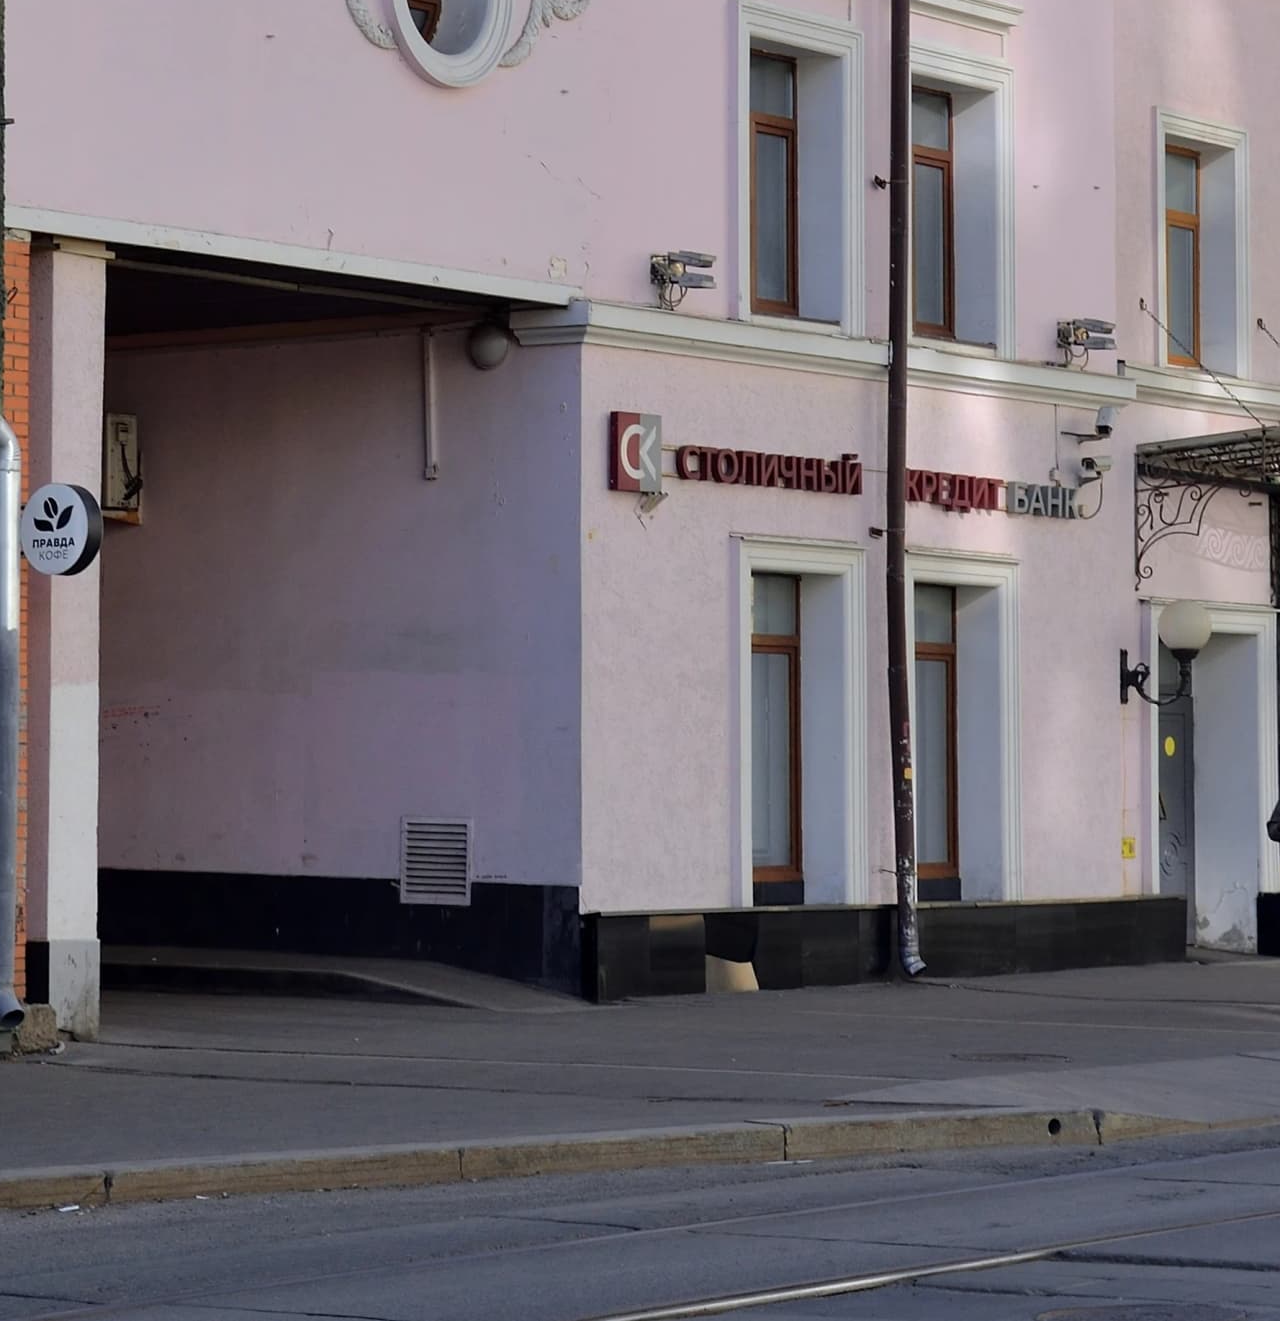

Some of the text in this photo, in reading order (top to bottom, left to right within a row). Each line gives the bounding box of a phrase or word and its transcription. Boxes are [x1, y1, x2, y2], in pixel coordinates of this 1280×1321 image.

[677, 445, 862, 495] СТОЛИЧНЫЙ
[905, 468, 1004, 513] КРЕДИТ
[32, 536, 76, 549] ПРАВДА
[38, 549, 69, 561] КОФЕ
